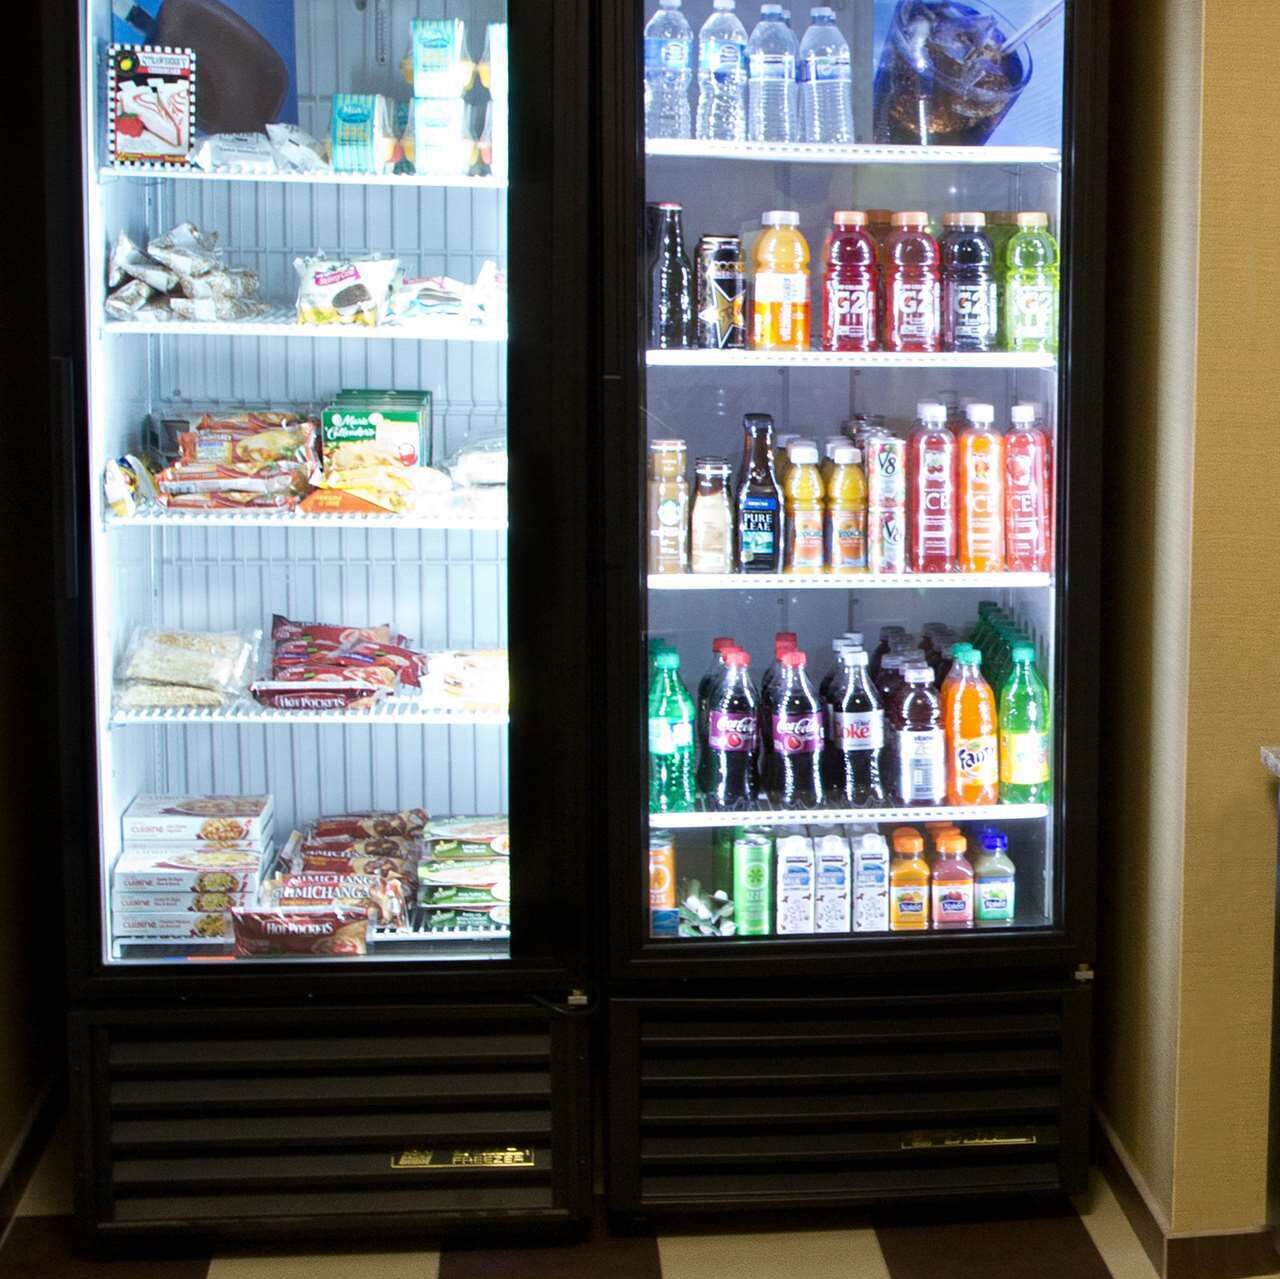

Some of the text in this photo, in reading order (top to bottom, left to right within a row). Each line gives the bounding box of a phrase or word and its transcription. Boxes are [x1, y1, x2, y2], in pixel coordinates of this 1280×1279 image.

[834, 290, 866, 314] G2
[877, 450, 898, 476] V8
[743, 511, 774, 523] PURE
[743, 521, 772, 532] LEAF
